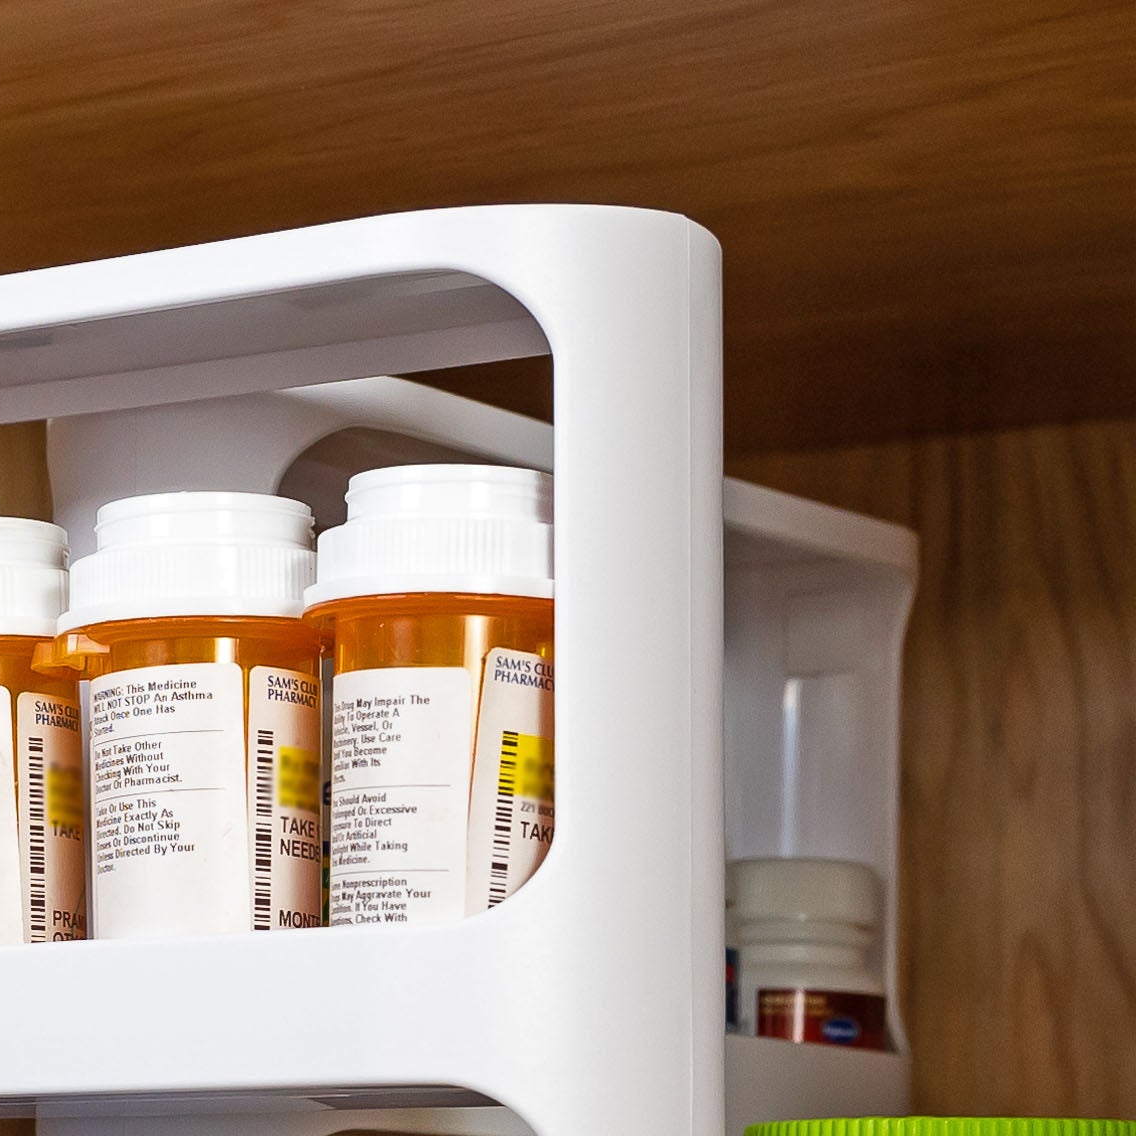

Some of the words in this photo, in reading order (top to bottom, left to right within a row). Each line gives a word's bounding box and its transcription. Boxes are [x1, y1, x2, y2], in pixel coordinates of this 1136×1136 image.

[496, 656, 531, 672] SAM'S
[535, 663, 554, 677] CLU
[126, 684, 144, 694] This
[148, 680, 197, 691] Medicine
[268, 675, 298, 691] SAM'S
[494, 670, 554, 692] PHARMAC
[125, 694, 150, 706] STOP
[154, 694, 167, 702] An
[171, 691, 213, 701] Asthma
[375, 696, 405, 708] Impair
[410, 695, 430, 704] The
[35, 701, 63, 715] SAM'S
[133, 707, 152, 716] One
[156, 705, 175, 714] Has
[356, 709, 389, 721] Operate
[379, 733, 401, 742] Care
[362, 794, 386, 803] Avoid
[370, 805, 417, 815] Excessive
[280, 816, 315, 838] TAKE
[365, 818, 392, 827] Direct
[521, 821, 554, 844] TAK
[376, 842, 408, 852] Taking
[406, 889, 431, 898] Your
[382, 902, 406, 911] Have
